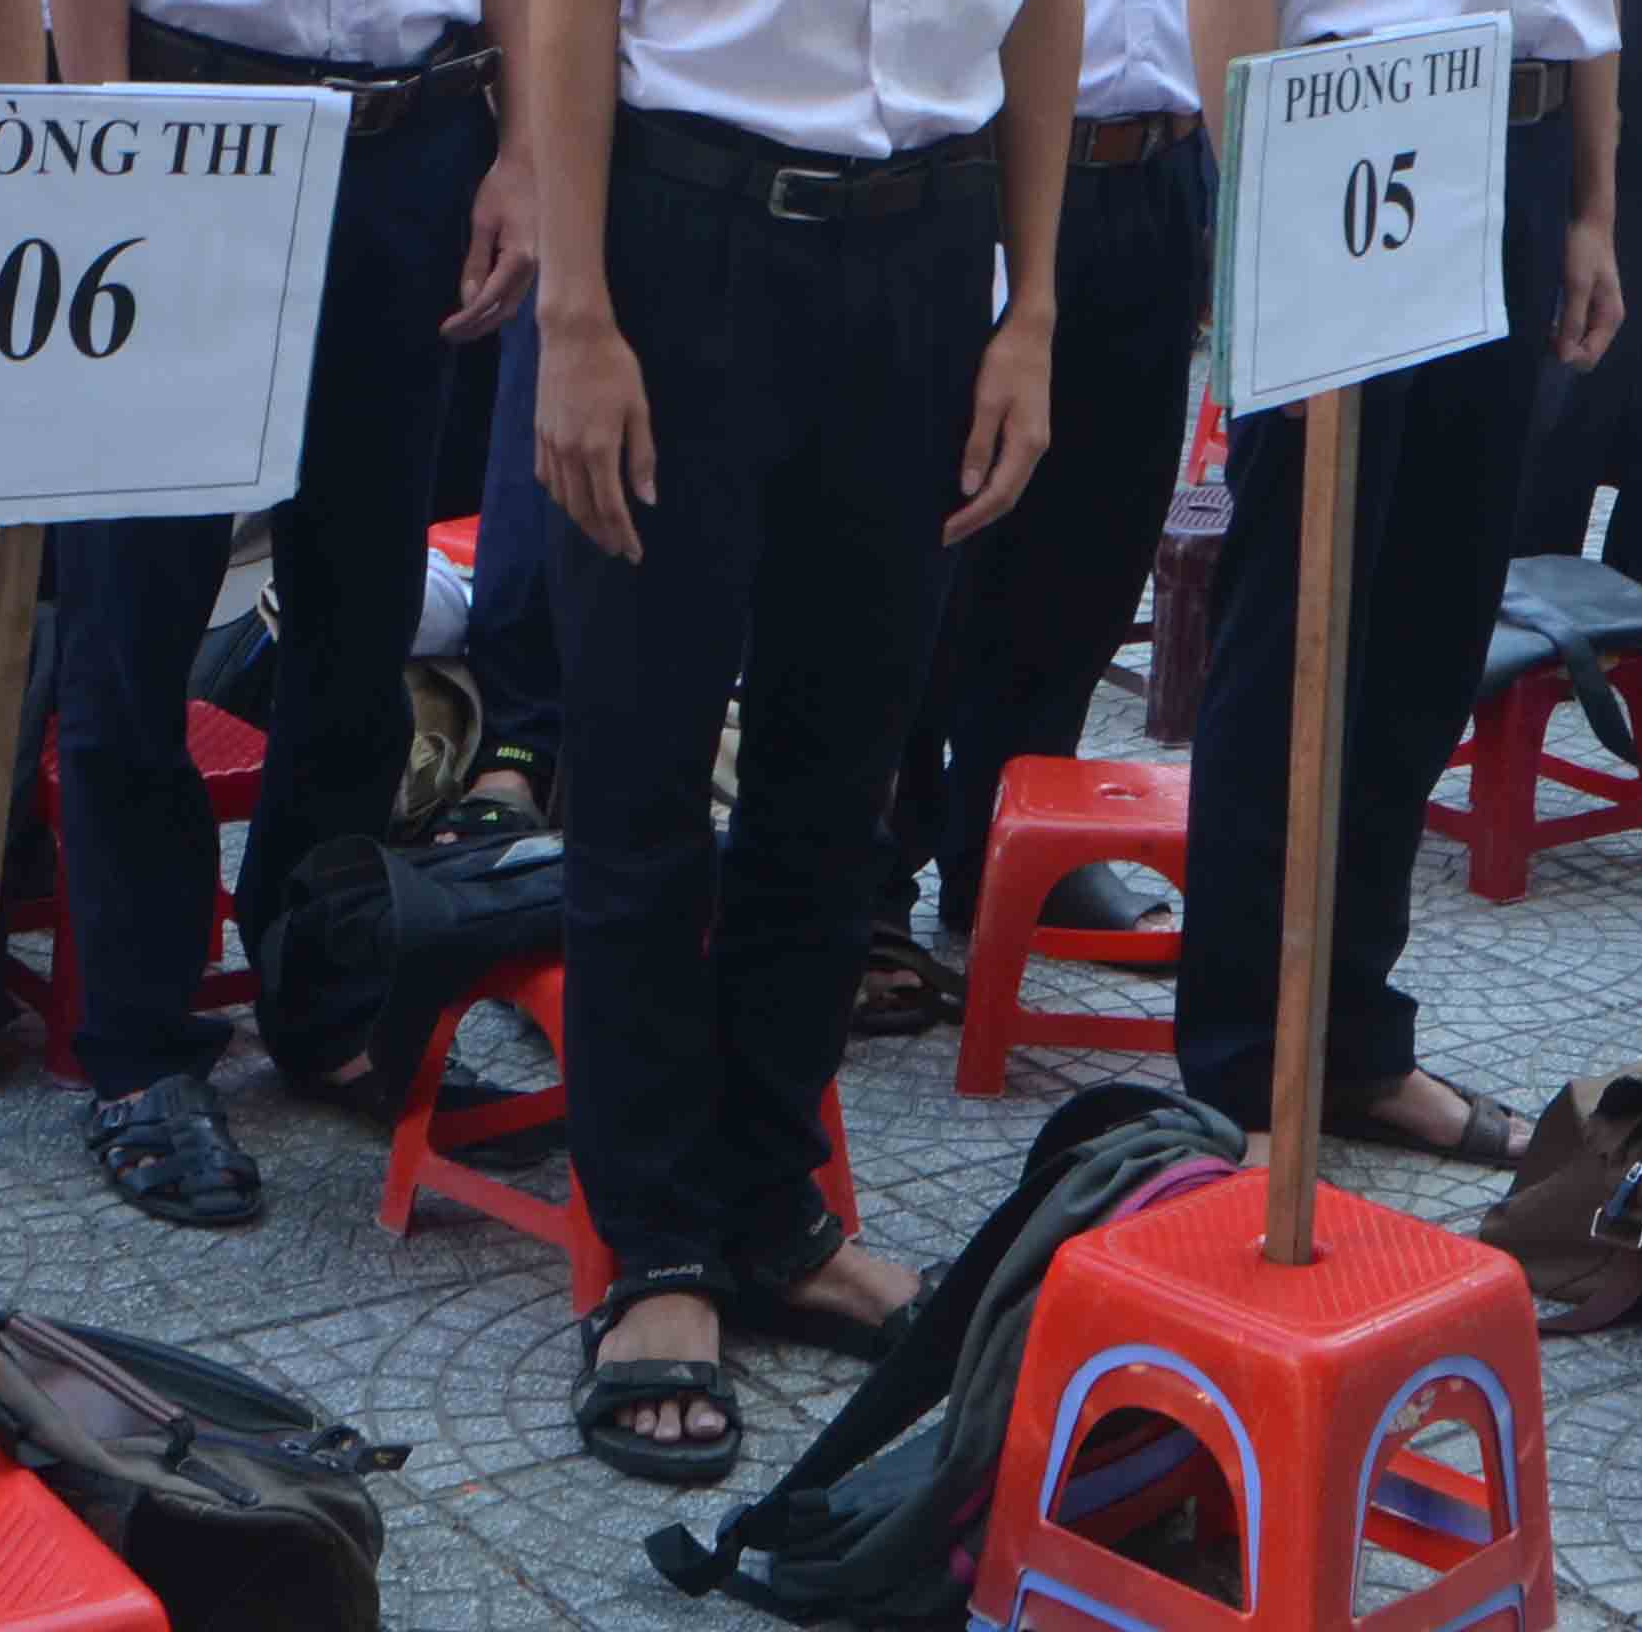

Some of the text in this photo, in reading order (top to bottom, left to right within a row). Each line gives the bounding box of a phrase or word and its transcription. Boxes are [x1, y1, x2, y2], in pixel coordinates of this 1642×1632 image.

[1283, 46, 1485, 122] PHÒNG THI
[162, 121, 285, 177] THI
[1343, 149, 1417, 258] 05
